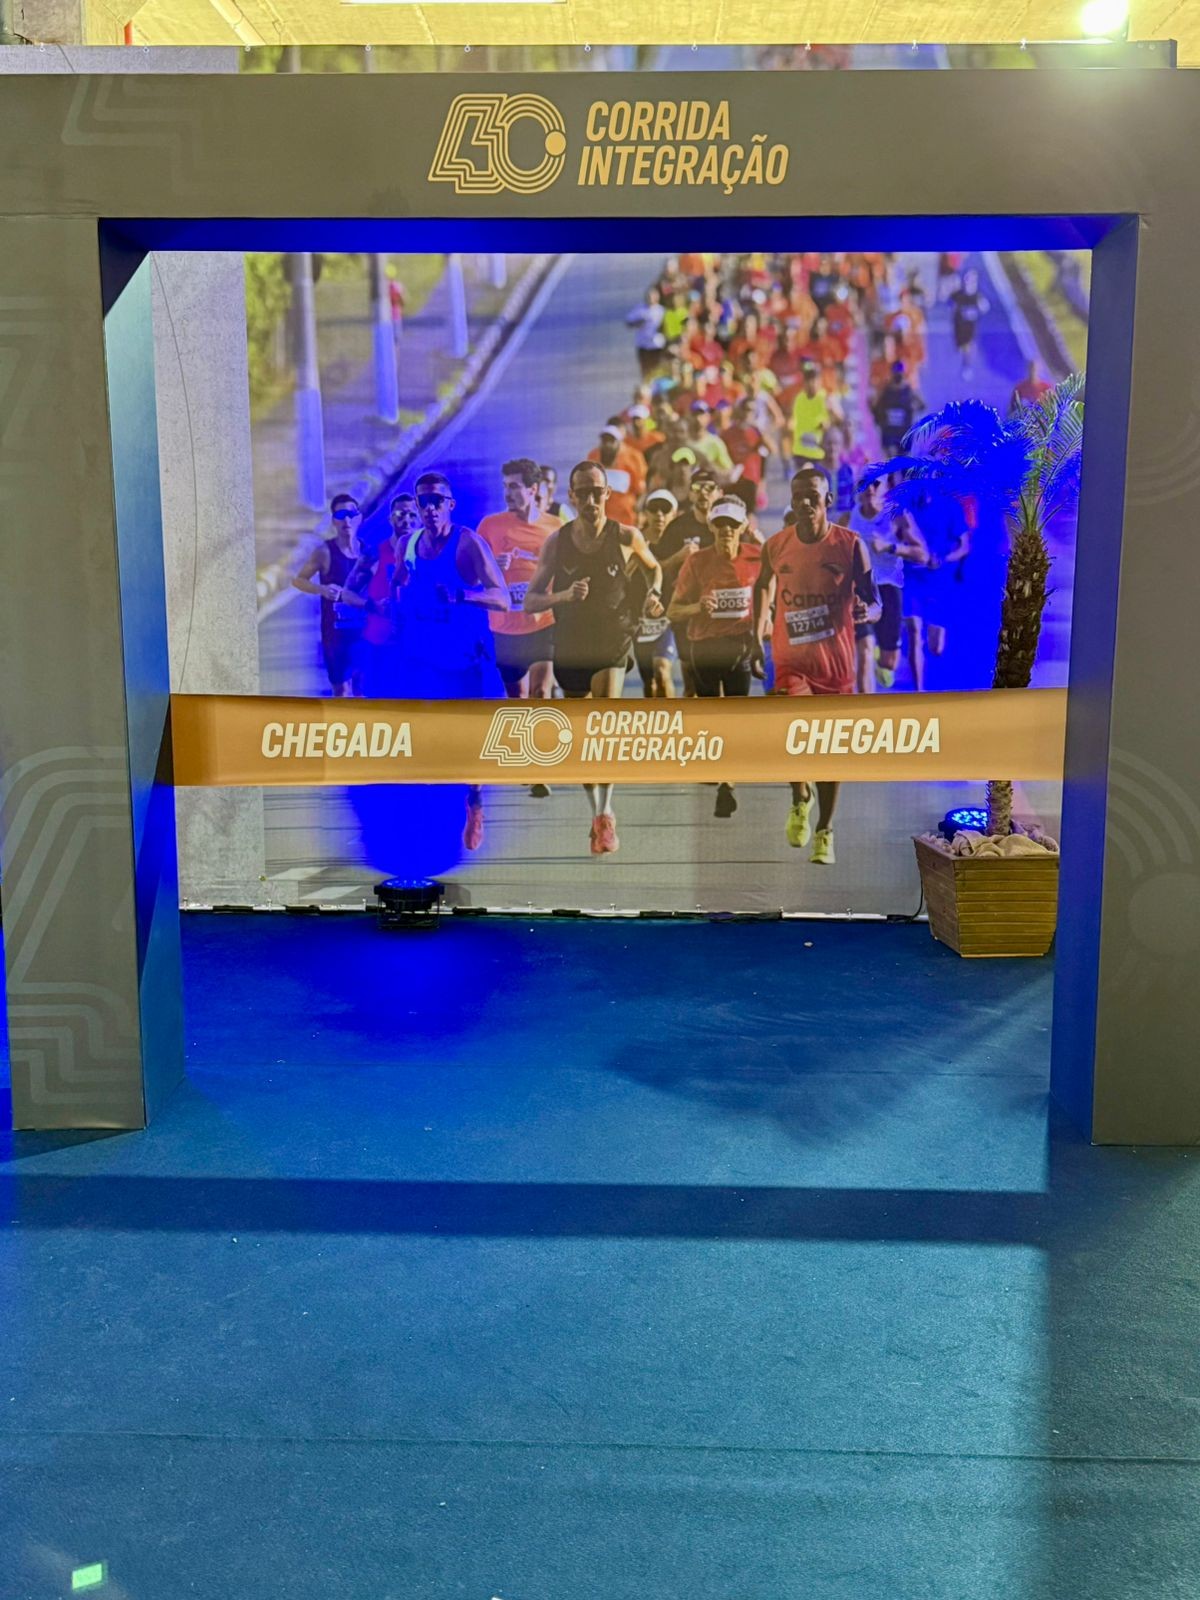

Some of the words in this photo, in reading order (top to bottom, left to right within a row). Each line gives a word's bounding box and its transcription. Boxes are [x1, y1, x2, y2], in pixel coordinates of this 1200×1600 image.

[585, 100, 731, 142] CORRIDA
[577, 133, 790, 195] INTEGRAÇÃO
[261, 722, 413, 758] CHEGADA
[585, 710, 684, 735] CORRIDA
[785, 717, 941, 755] CHEGADA
[580, 729, 724, 767] INTEGRAÇÃO
